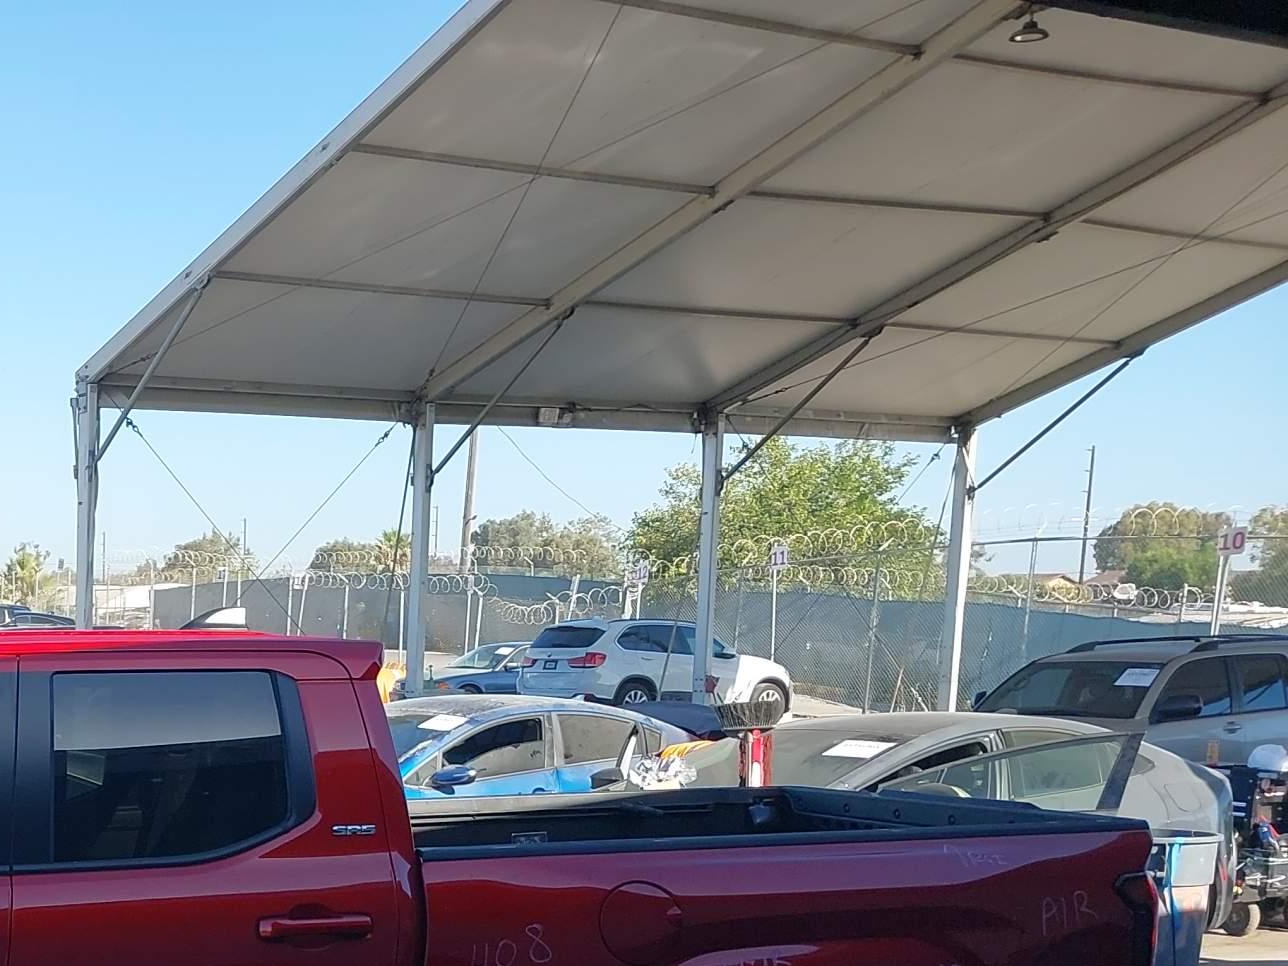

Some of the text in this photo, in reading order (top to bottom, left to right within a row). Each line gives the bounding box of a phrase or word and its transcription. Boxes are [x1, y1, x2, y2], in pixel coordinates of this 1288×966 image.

[1219, 532, 1245, 551] 10
[772, 550, 786, 566] 11
[332, 824, 377, 836] SR5
